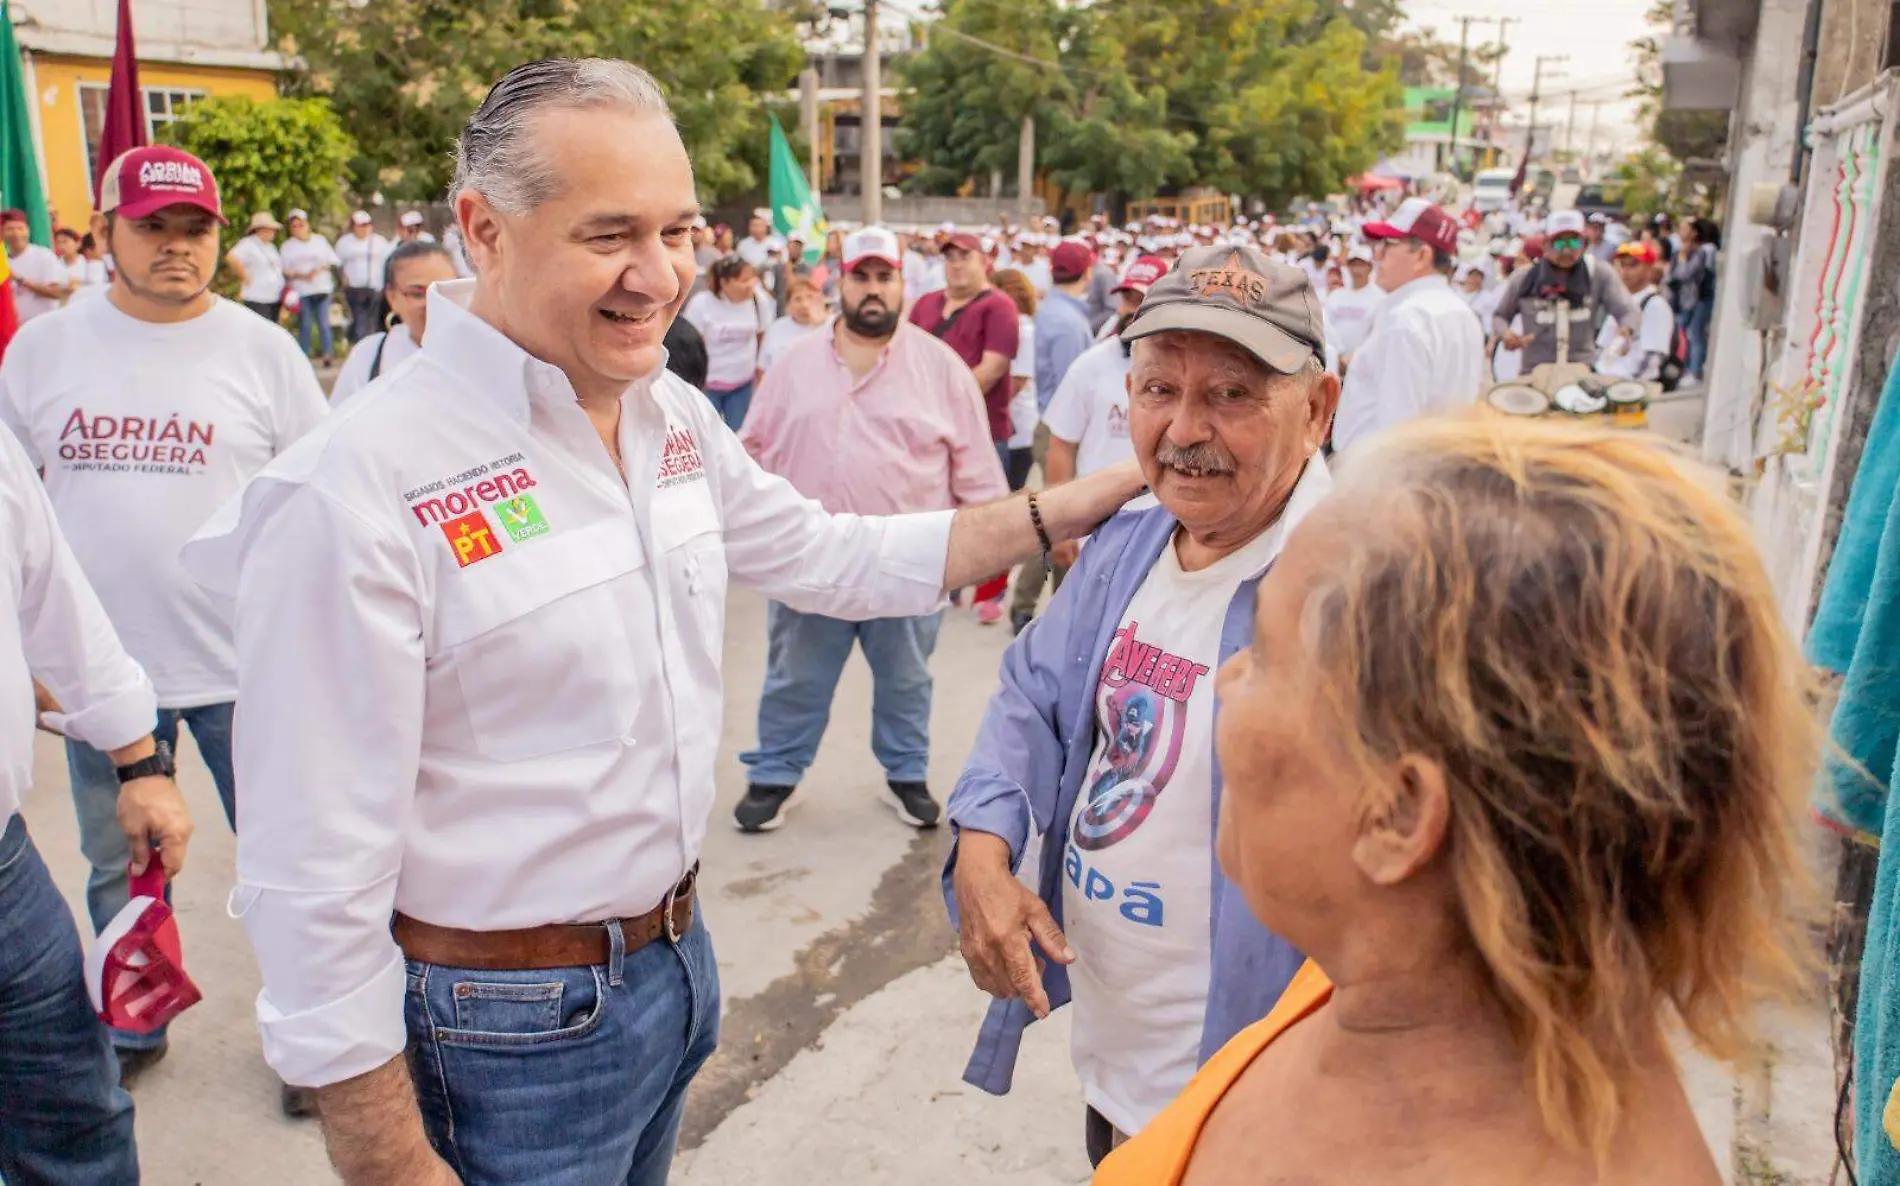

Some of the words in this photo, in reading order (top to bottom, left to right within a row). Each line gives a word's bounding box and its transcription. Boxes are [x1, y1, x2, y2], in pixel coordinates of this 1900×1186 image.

[1190, 269, 1266, 302] TEXAS
[59, 407, 215, 446] ADRIÁN
[59, 443, 206, 466] OSEGUERA
[71, 463, 130, 473] DIPUTADO
[133, 464, 191, 475] FEDERAL
[403, 480, 446, 502] SIGAMOS
[446, 464, 488, 487] HACIENDO
[411, 468, 537, 528] morena
[453, 527, 493, 564] PT
[1065, 843, 1163, 927] apá
